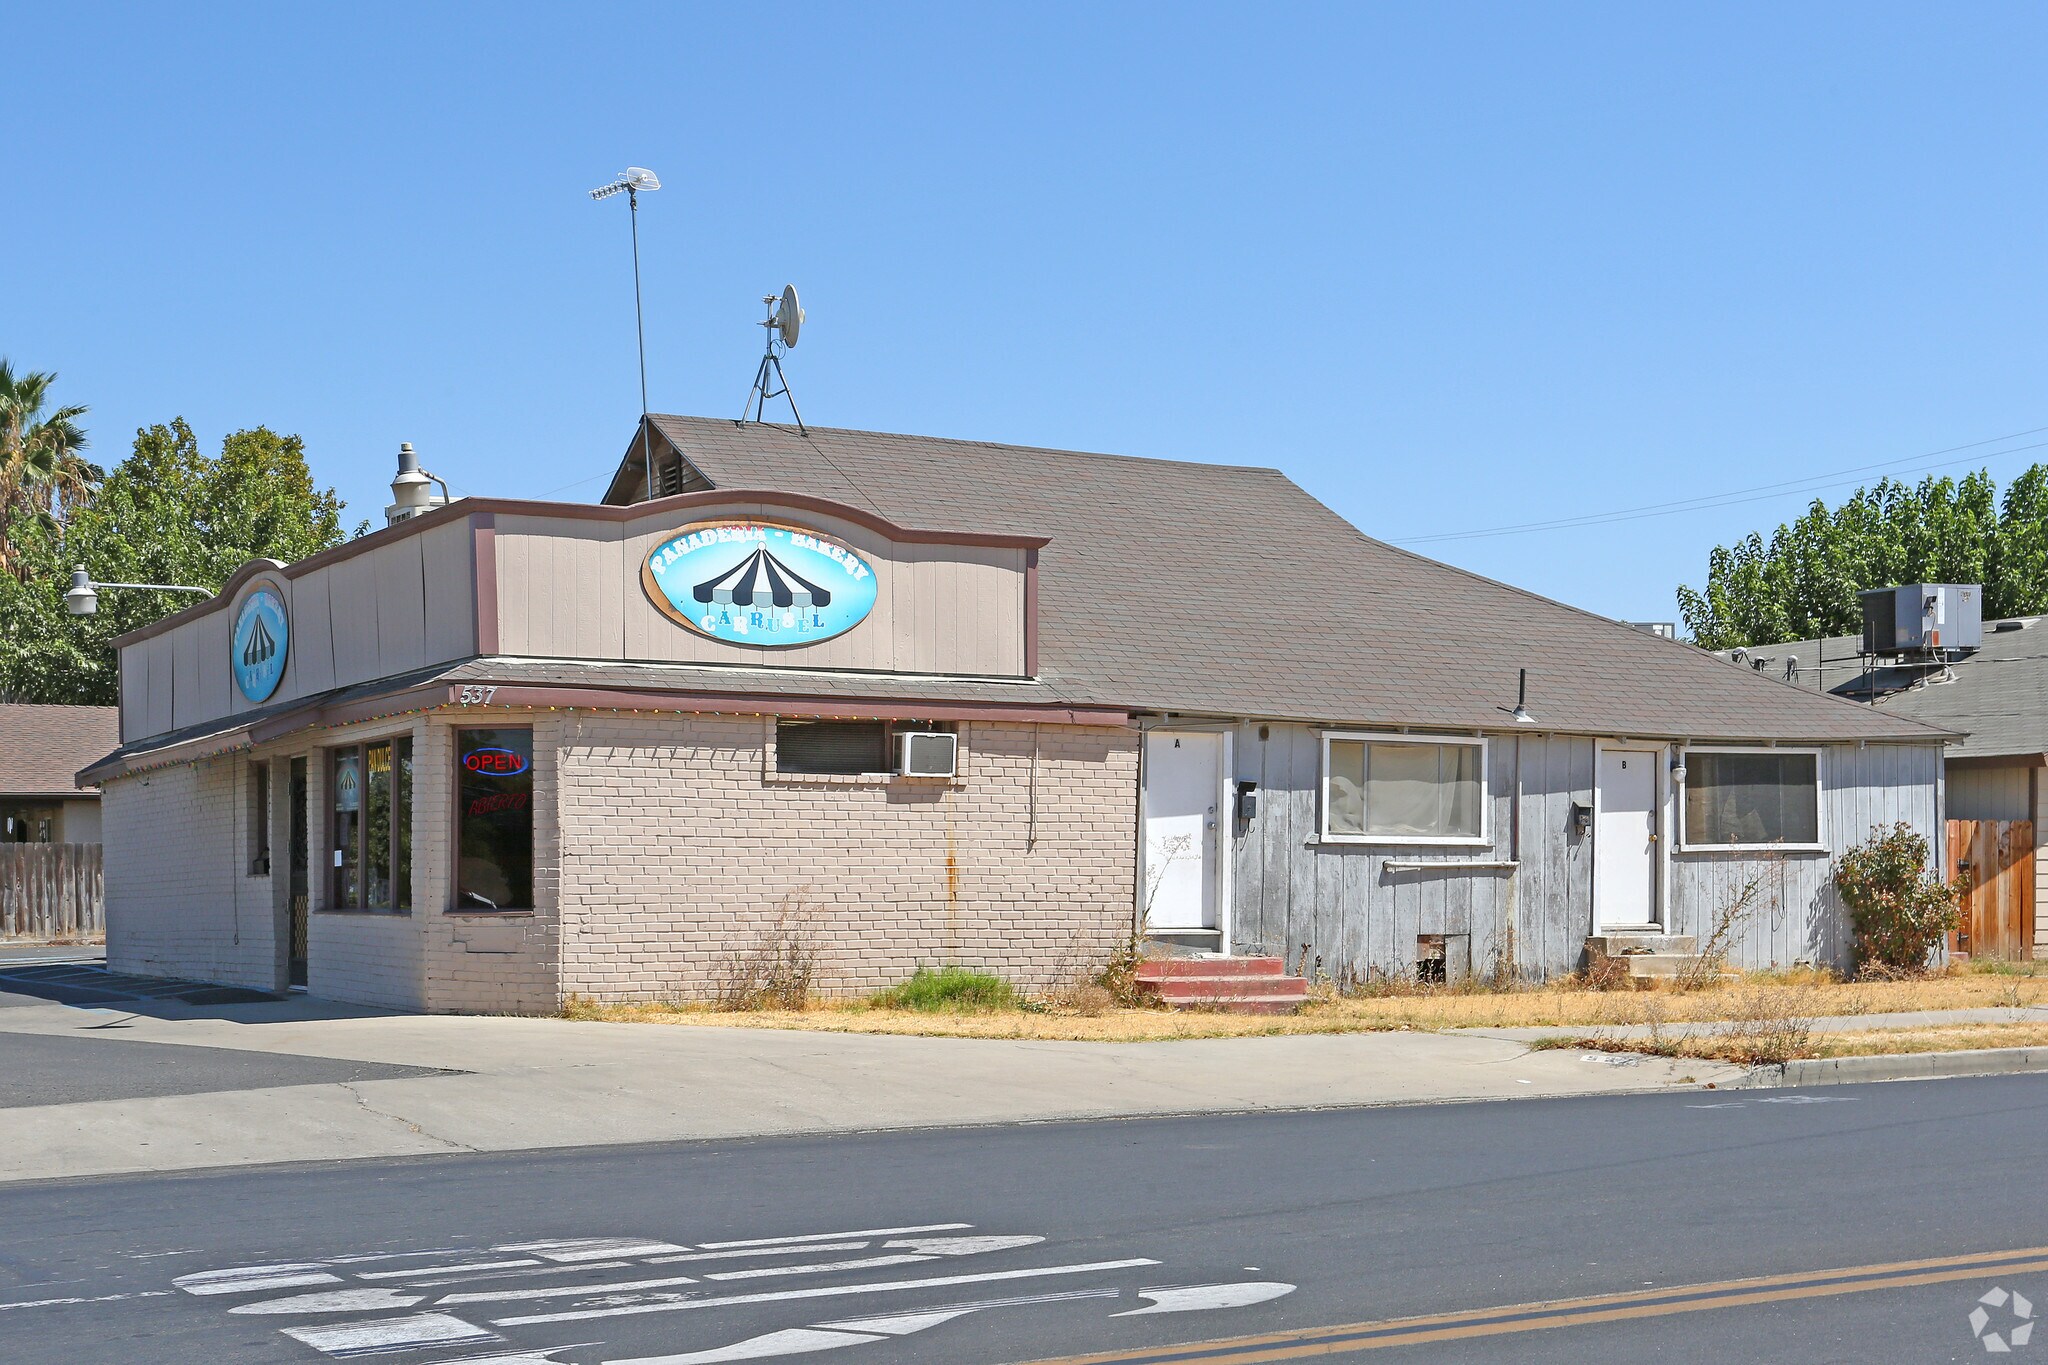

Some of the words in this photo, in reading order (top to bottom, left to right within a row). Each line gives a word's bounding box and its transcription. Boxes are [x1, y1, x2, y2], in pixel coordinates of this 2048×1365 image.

[790, 532, 869, 581] BAKERY
[700, 610, 825, 635] CARRUSEL
[460, 685, 498, 704] 537
[1174, 738, 1181, 749] A
[466, 754, 522, 771] OPEN
[1621, 760, 1627, 770] B
[467, 793, 528, 817] ABIERTO
